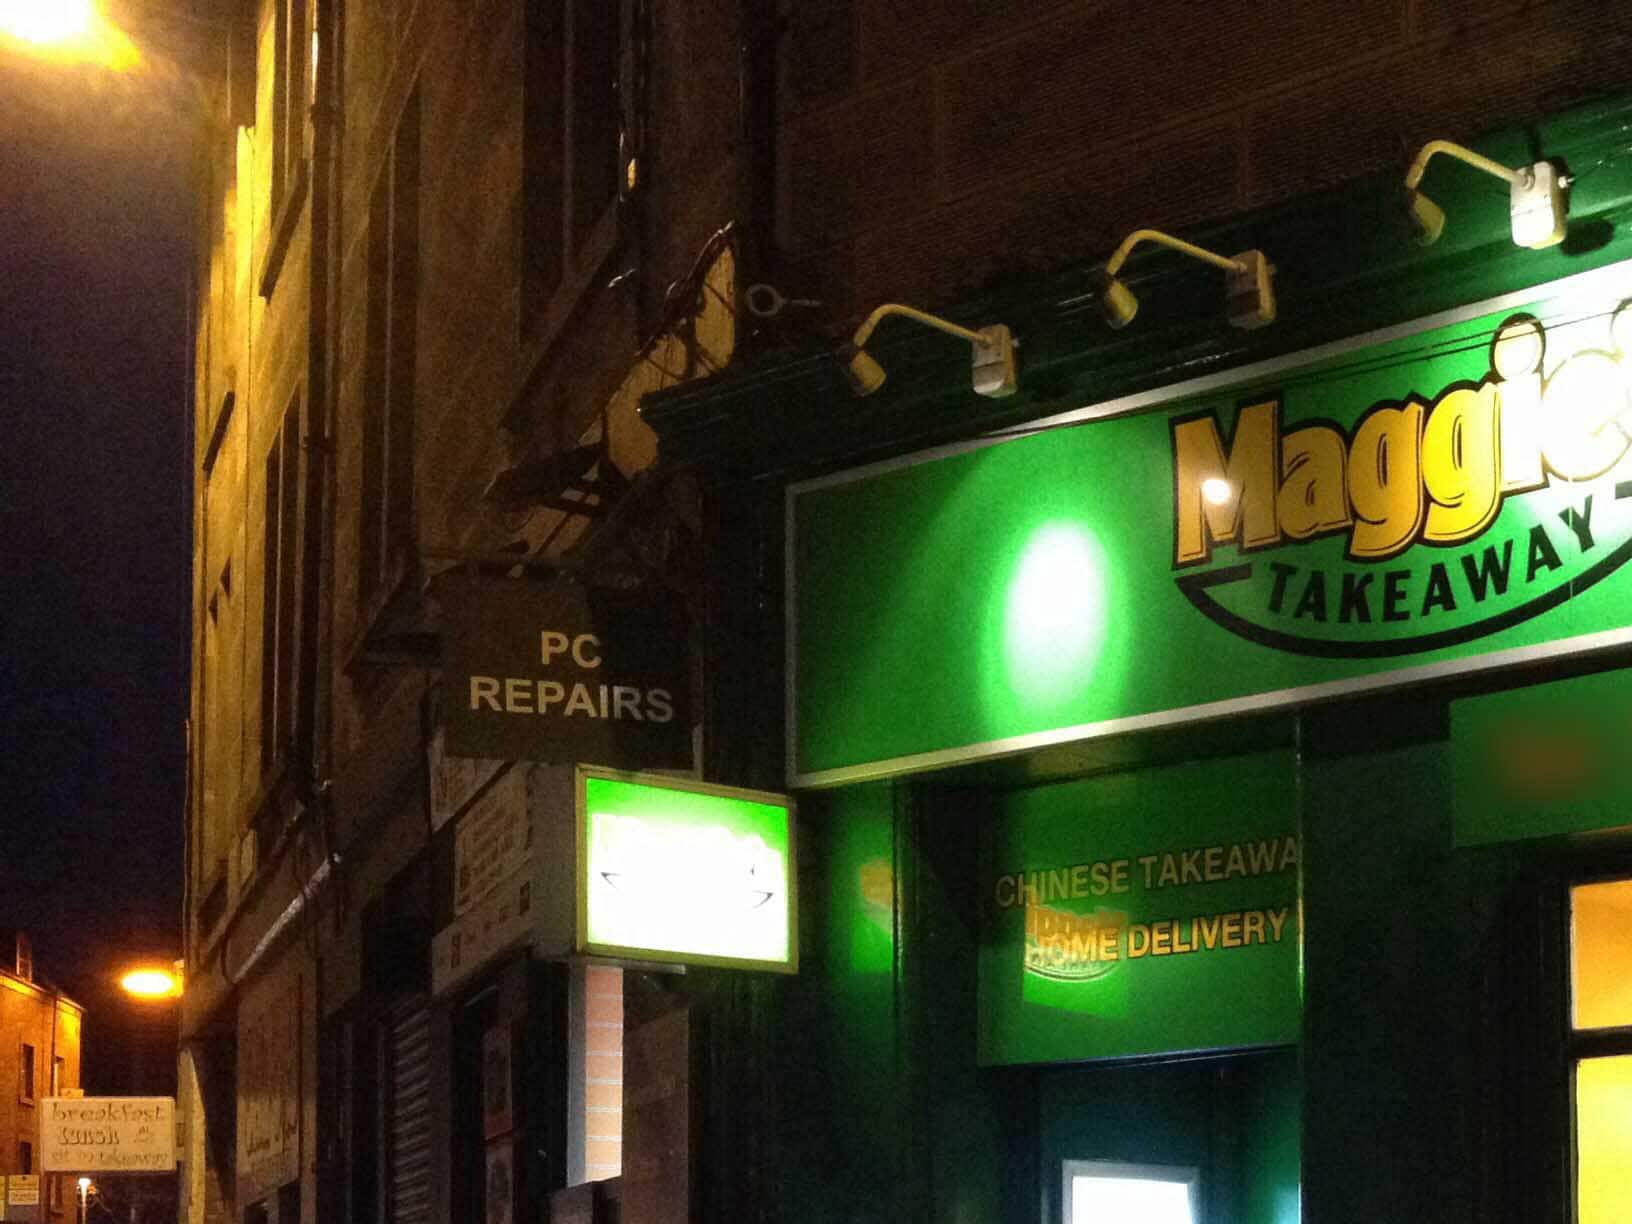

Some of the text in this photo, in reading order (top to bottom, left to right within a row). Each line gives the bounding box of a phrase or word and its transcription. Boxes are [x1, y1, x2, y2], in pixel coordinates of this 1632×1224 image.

[1266, 494, 1598, 626] TAKEAWAY
[540, 631, 602, 668] PC
[469, 676, 674, 724] REPAIRS
[994, 858, 1130, 909] CHINESE
[1127, 908, 1289, 959] DELIVERY
